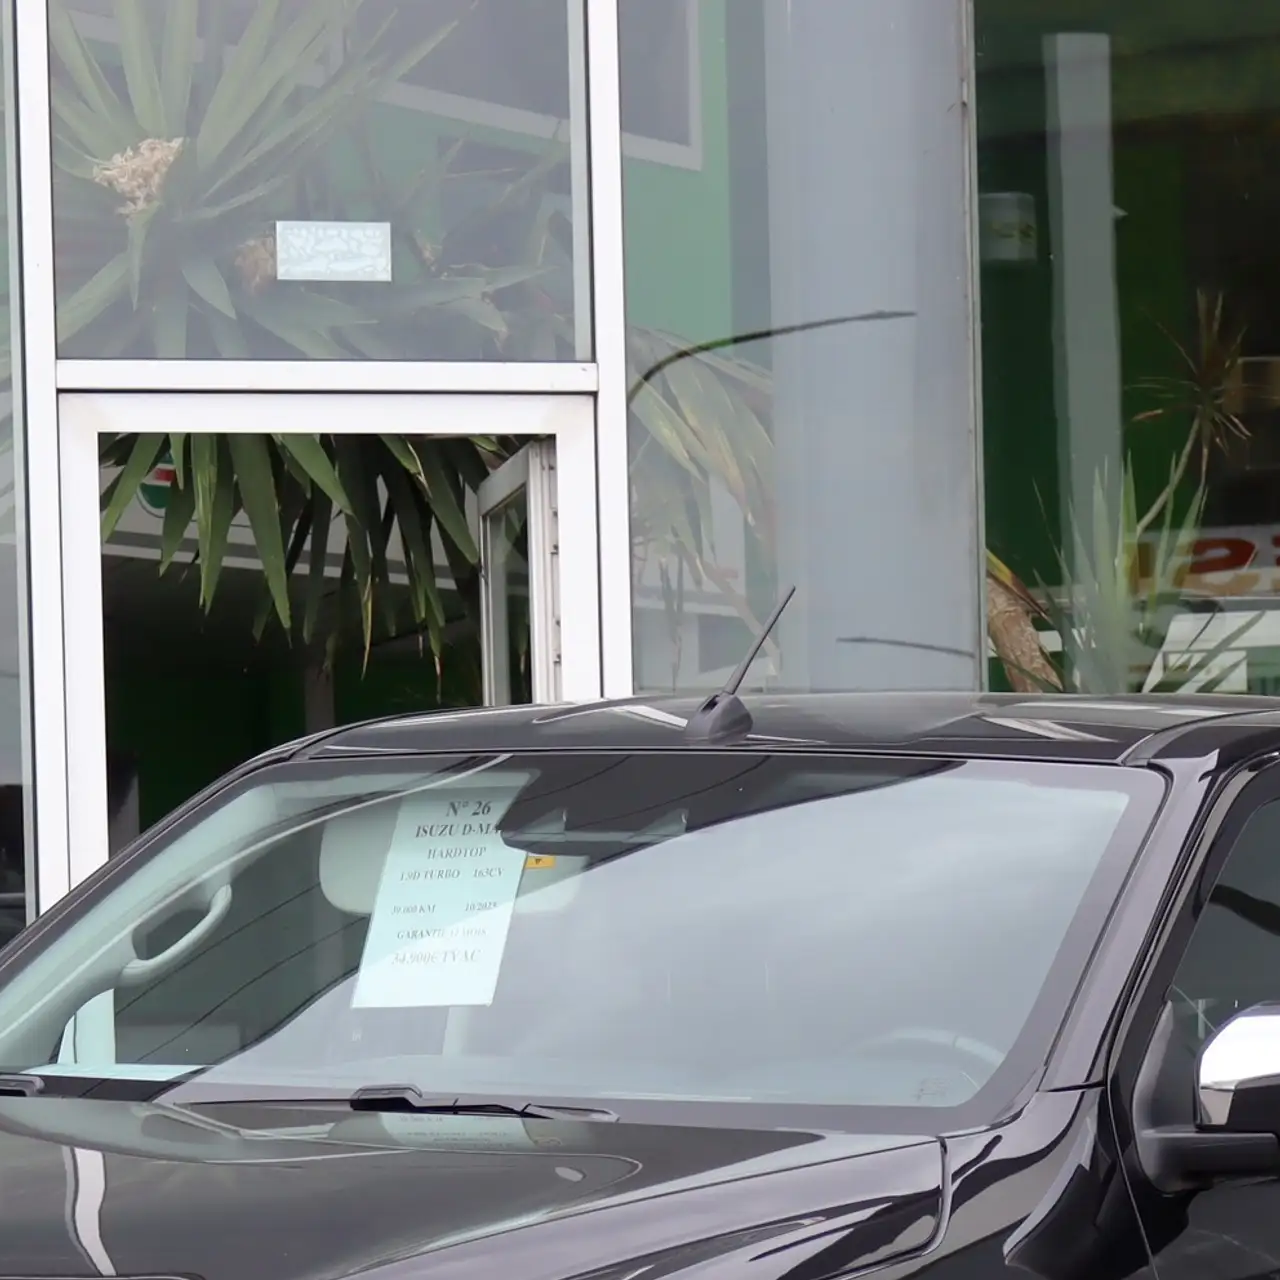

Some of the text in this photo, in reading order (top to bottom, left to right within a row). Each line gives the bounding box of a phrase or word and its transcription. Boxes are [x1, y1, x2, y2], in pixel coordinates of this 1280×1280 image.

[472, 800, 492, 816] 26
[415, 822, 459, 838] ISUZU
[427, 846, 487, 860] HARDTOP
[424, 868, 461, 880] TURBO
